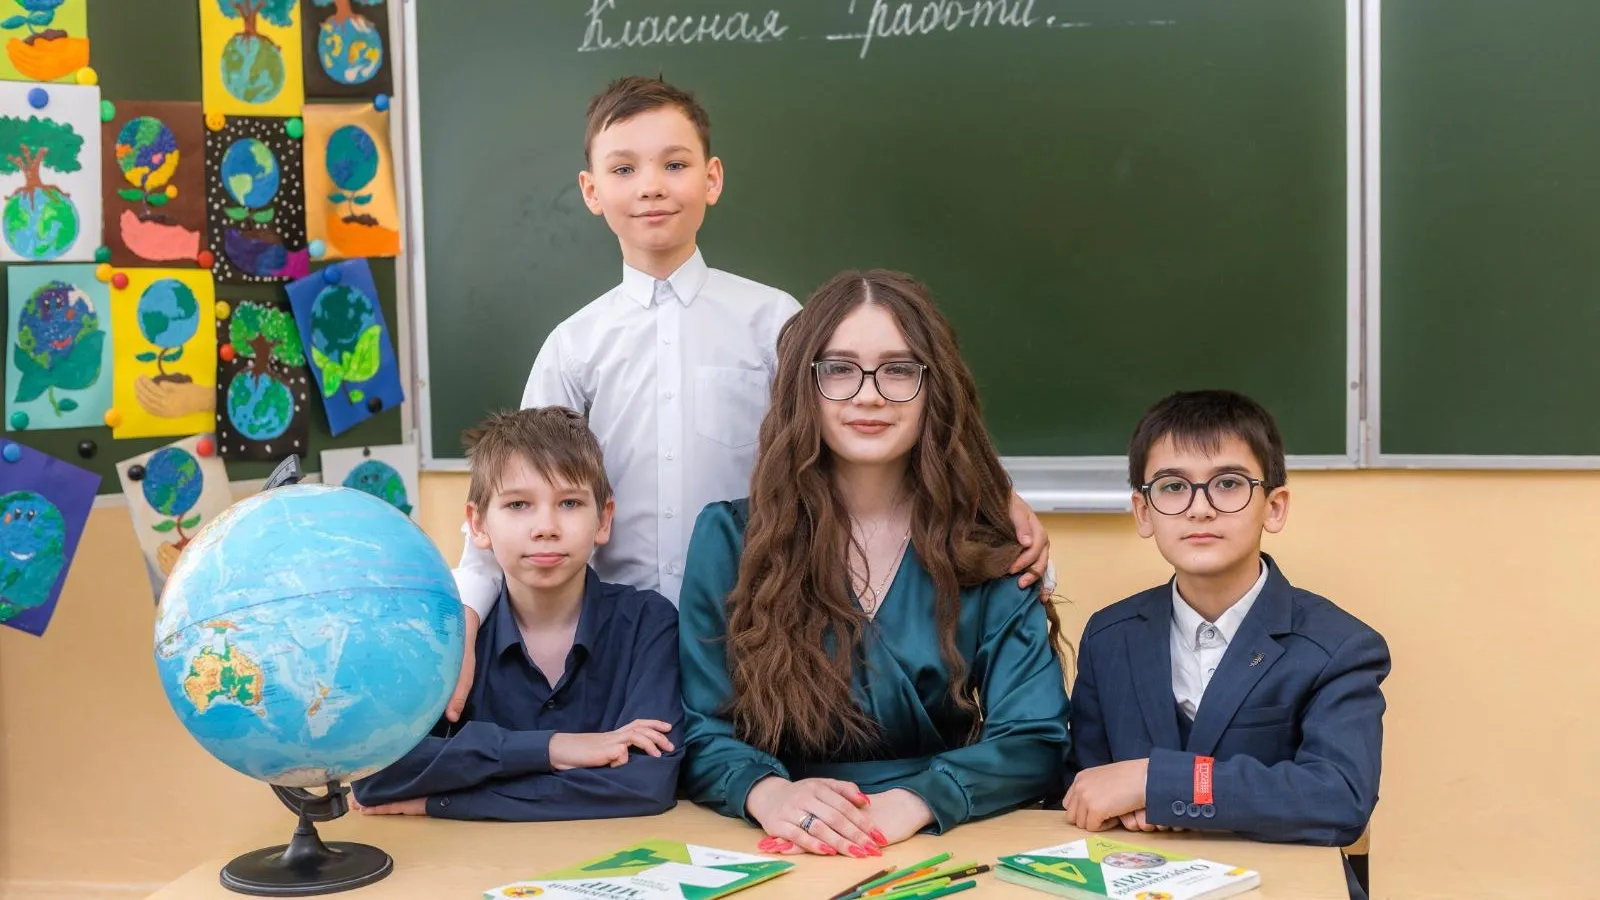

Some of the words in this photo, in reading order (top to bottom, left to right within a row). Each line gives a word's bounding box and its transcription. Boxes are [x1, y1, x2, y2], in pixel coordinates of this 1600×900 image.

[577, 0, 788, 53] Классная
[581, 848, 669, 871] 4
[1028, 862, 1088, 884] 4
